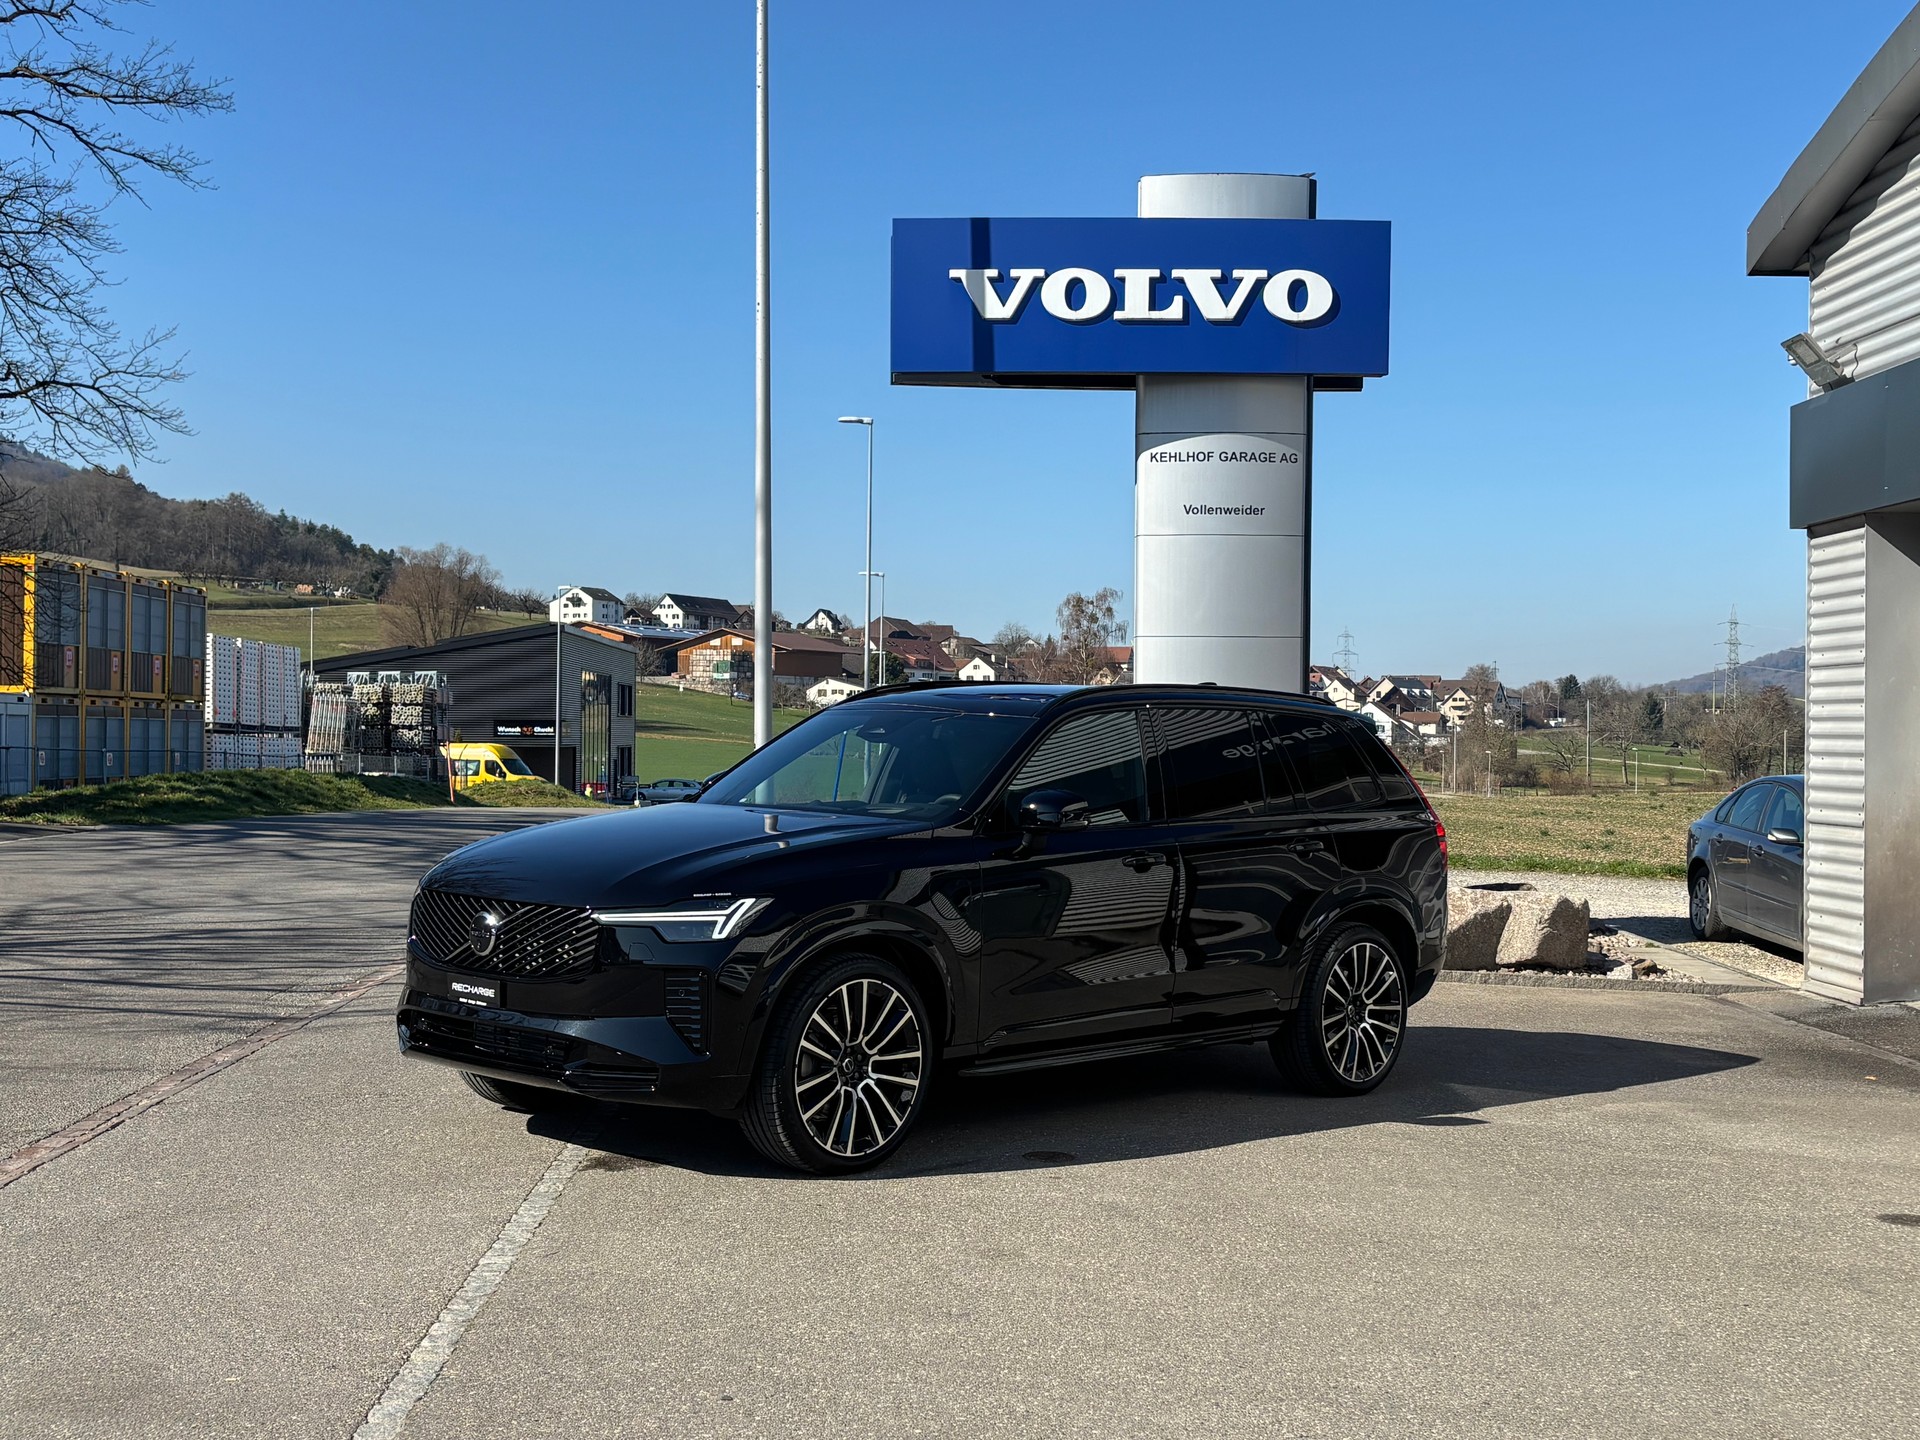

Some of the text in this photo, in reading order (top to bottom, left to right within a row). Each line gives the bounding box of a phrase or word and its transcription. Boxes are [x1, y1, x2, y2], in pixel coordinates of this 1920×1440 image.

[949, 267, 1334, 322] VOLVO
[1149, 451, 1299, 464] KEHLHOF GARAGE AG
[1183, 504, 1266, 516] Vollenweider
[451, 982, 495, 997] RECHARGE
